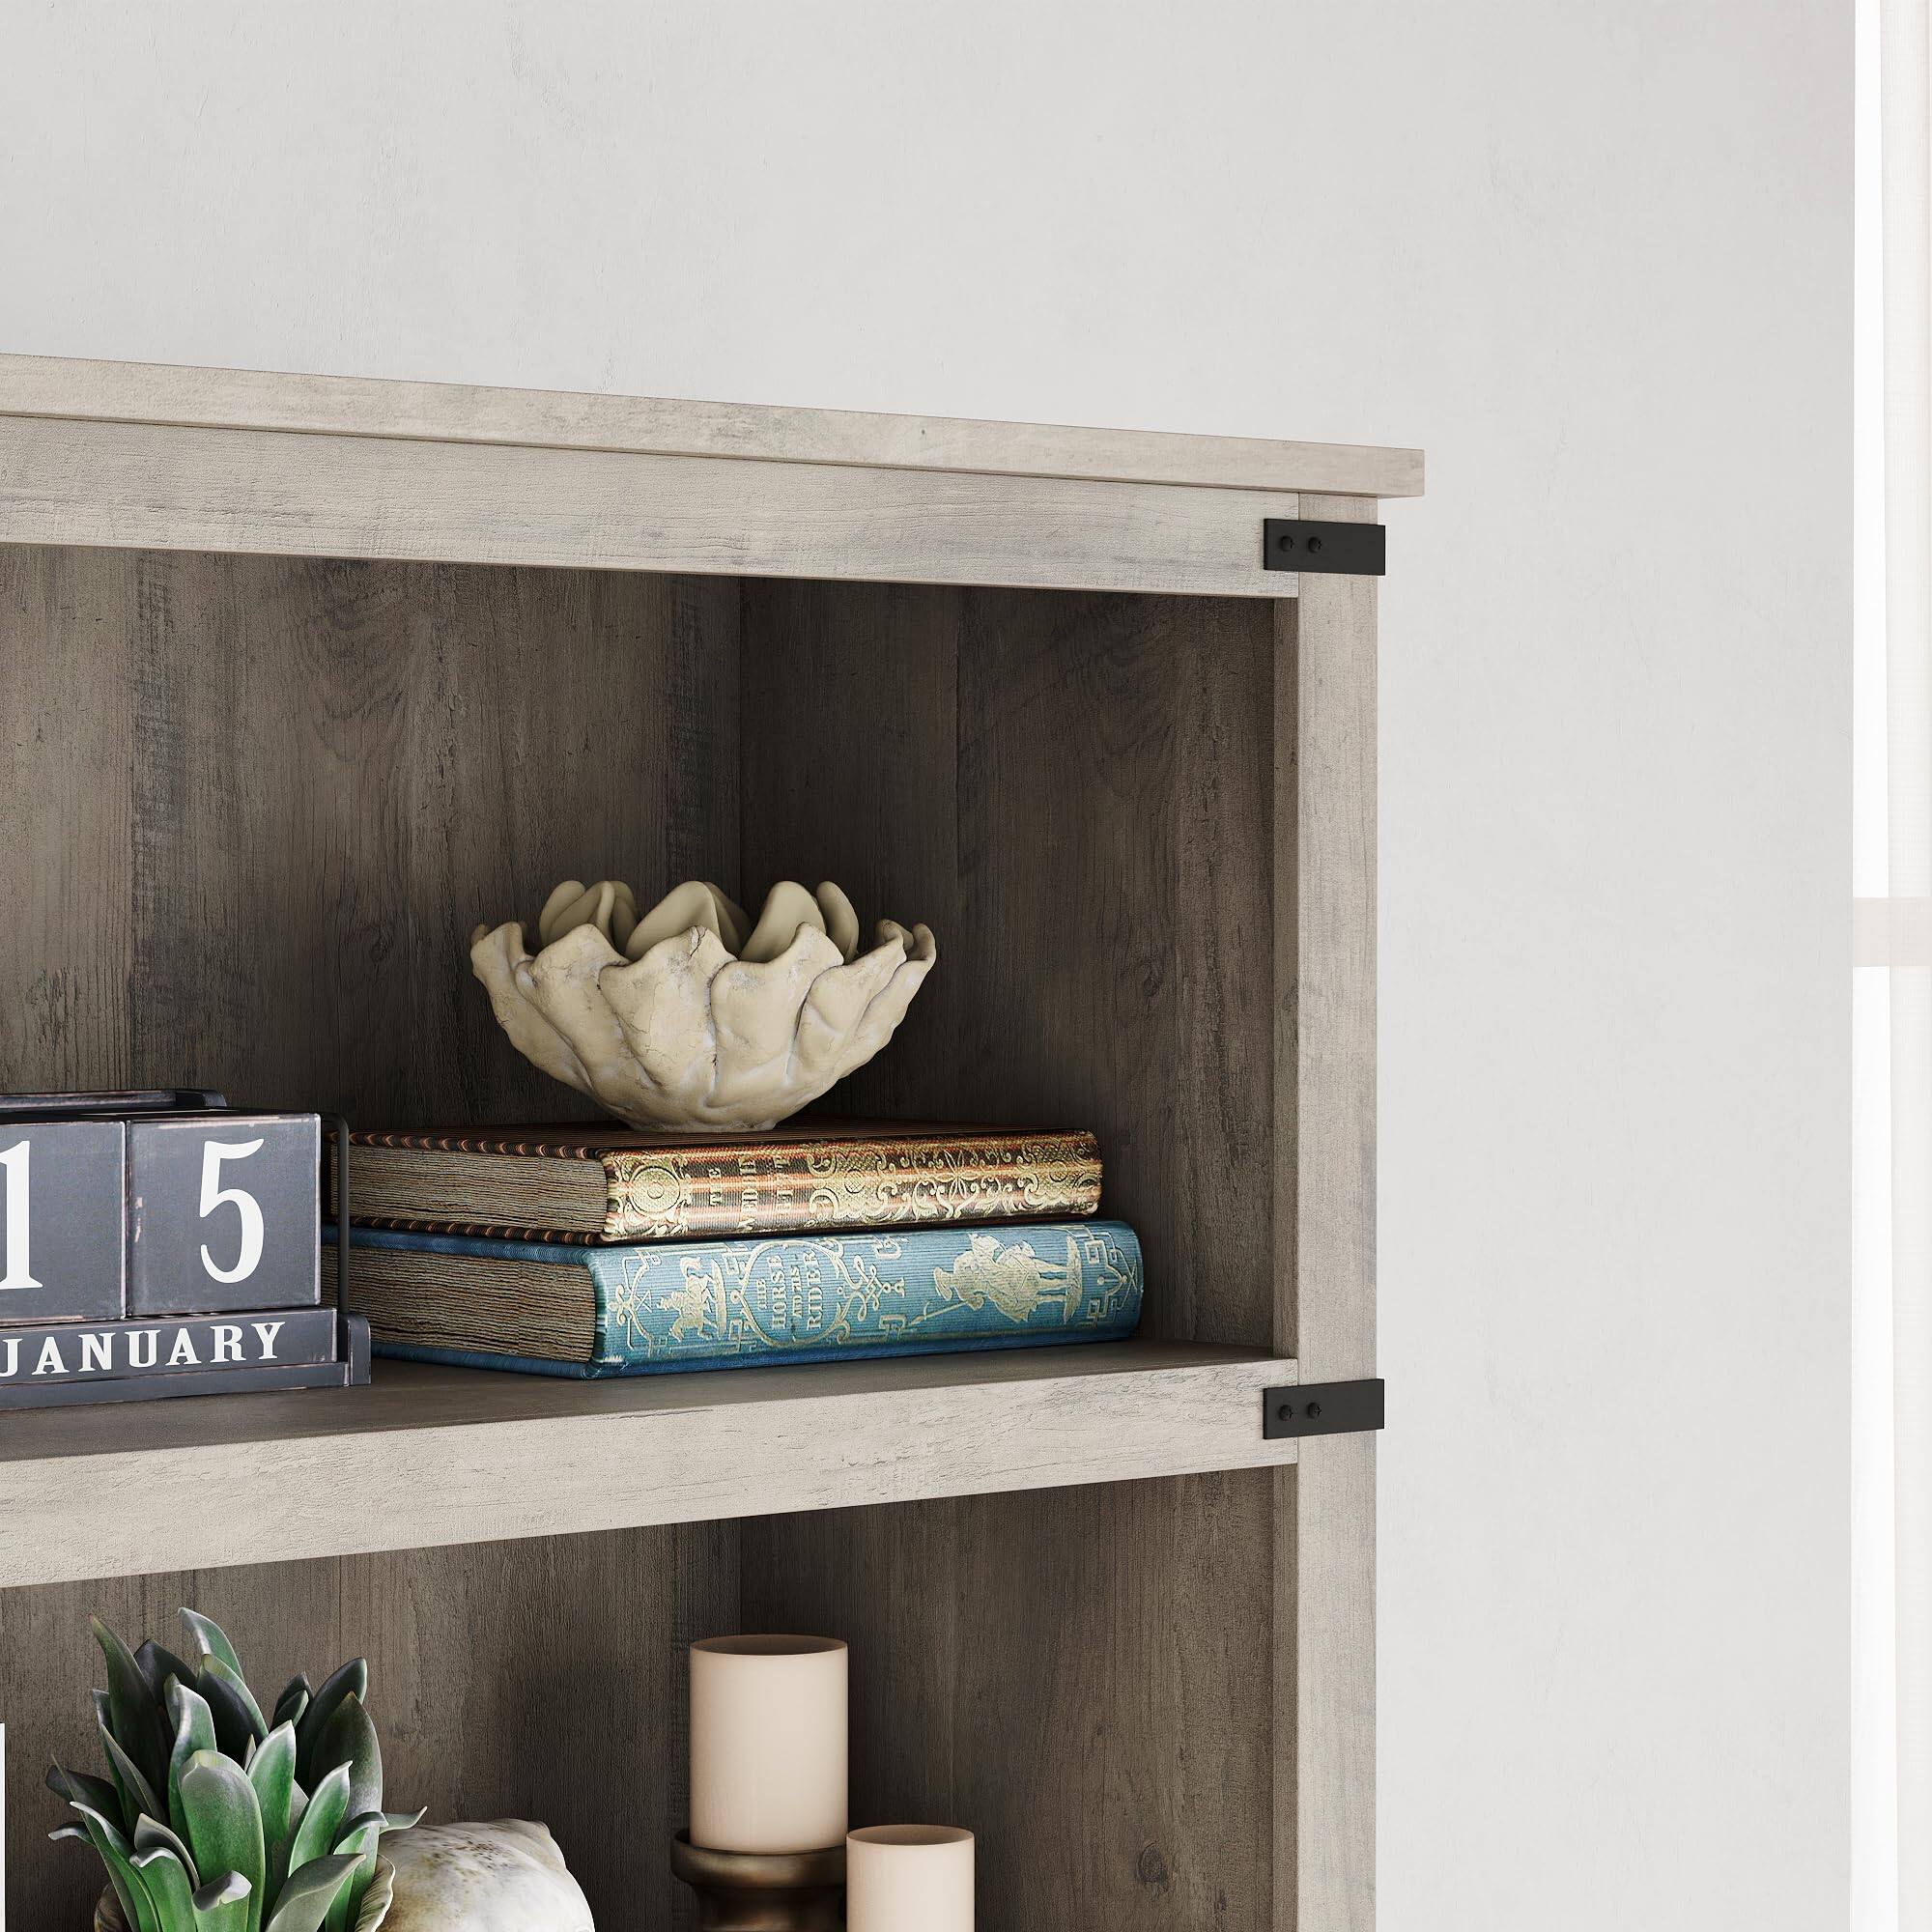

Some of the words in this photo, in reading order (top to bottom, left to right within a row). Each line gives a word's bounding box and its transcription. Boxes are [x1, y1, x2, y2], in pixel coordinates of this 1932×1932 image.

[199, 1138, 265, 1284] 5
[755, 1279, 768, 1311] THE
[767, 1255, 787, 1330] HORSE
[792, 1294, 803, 1319] AND
[803, 1249, 823, 1331] RIDER
[0, 1321, 286, 1378] JANUARY
